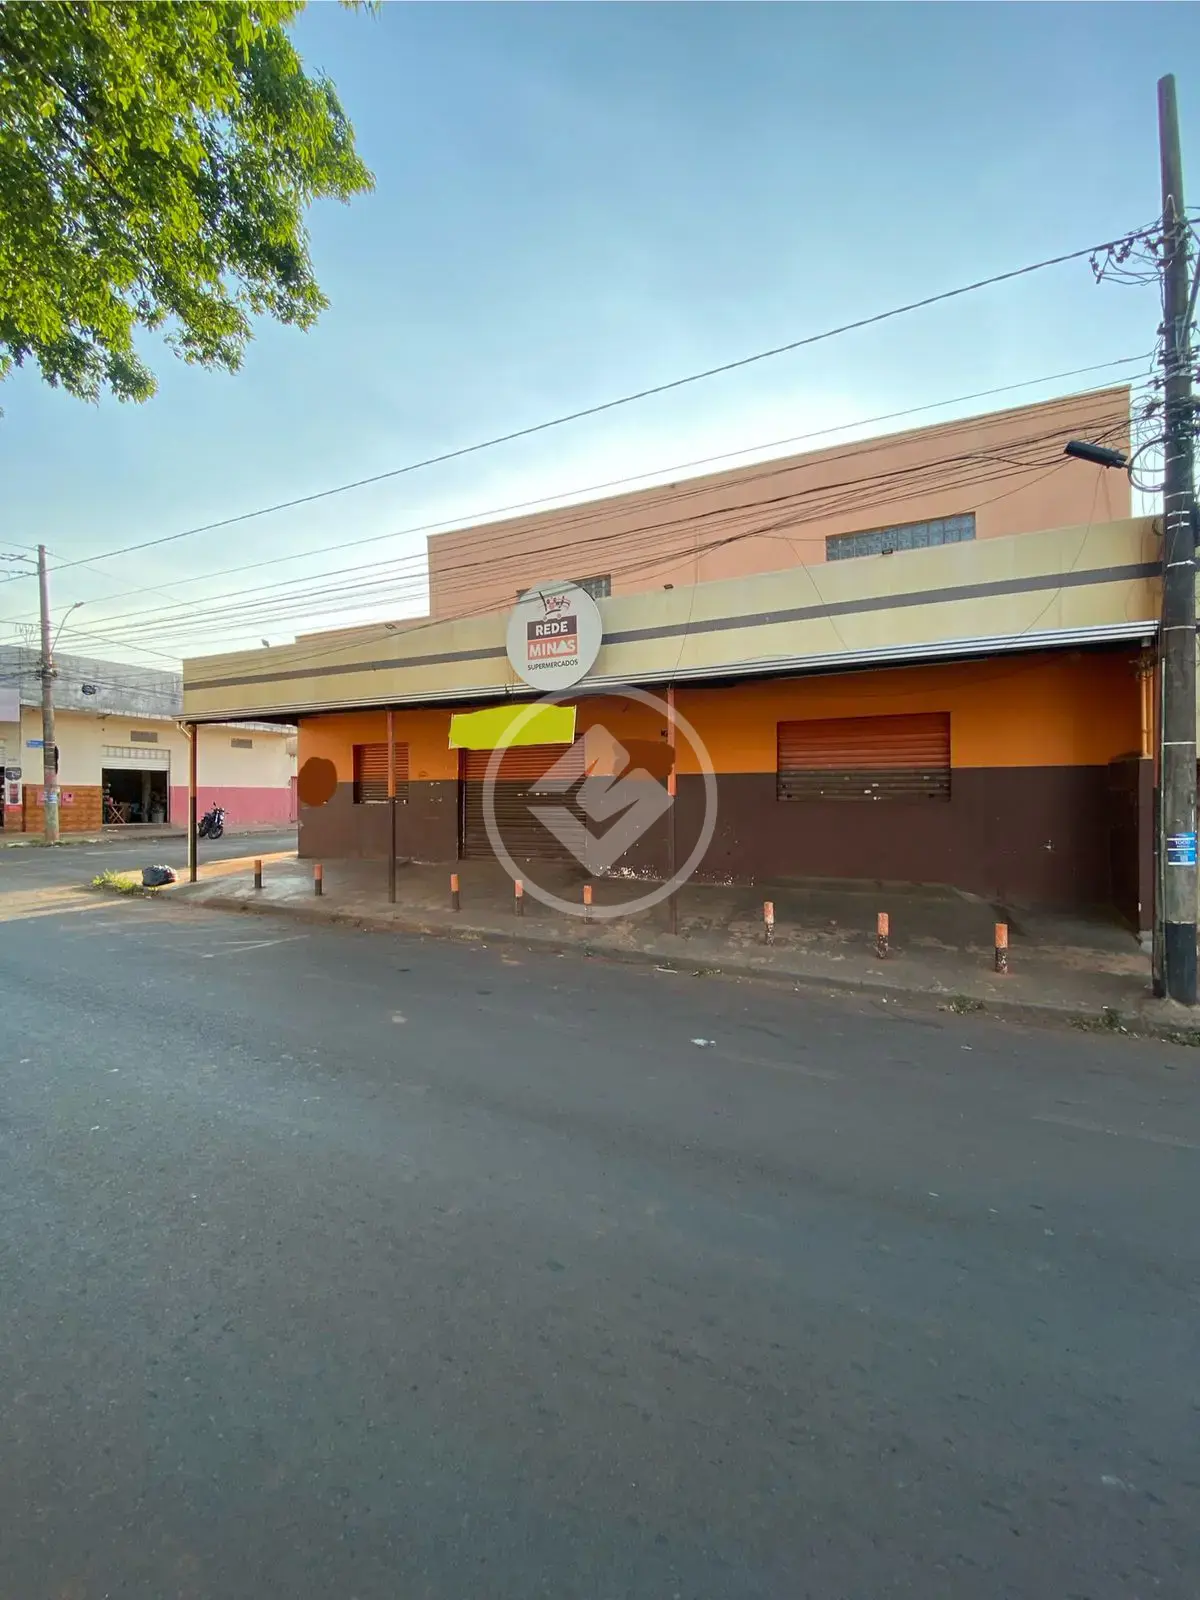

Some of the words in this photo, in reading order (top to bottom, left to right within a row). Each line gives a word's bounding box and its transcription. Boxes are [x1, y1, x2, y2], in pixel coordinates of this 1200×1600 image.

[535, 621, 568, 636] REDE
[529, 640, 576, 657] MINAS
[527, 659, 578, 670] SUPERMERCADOS
